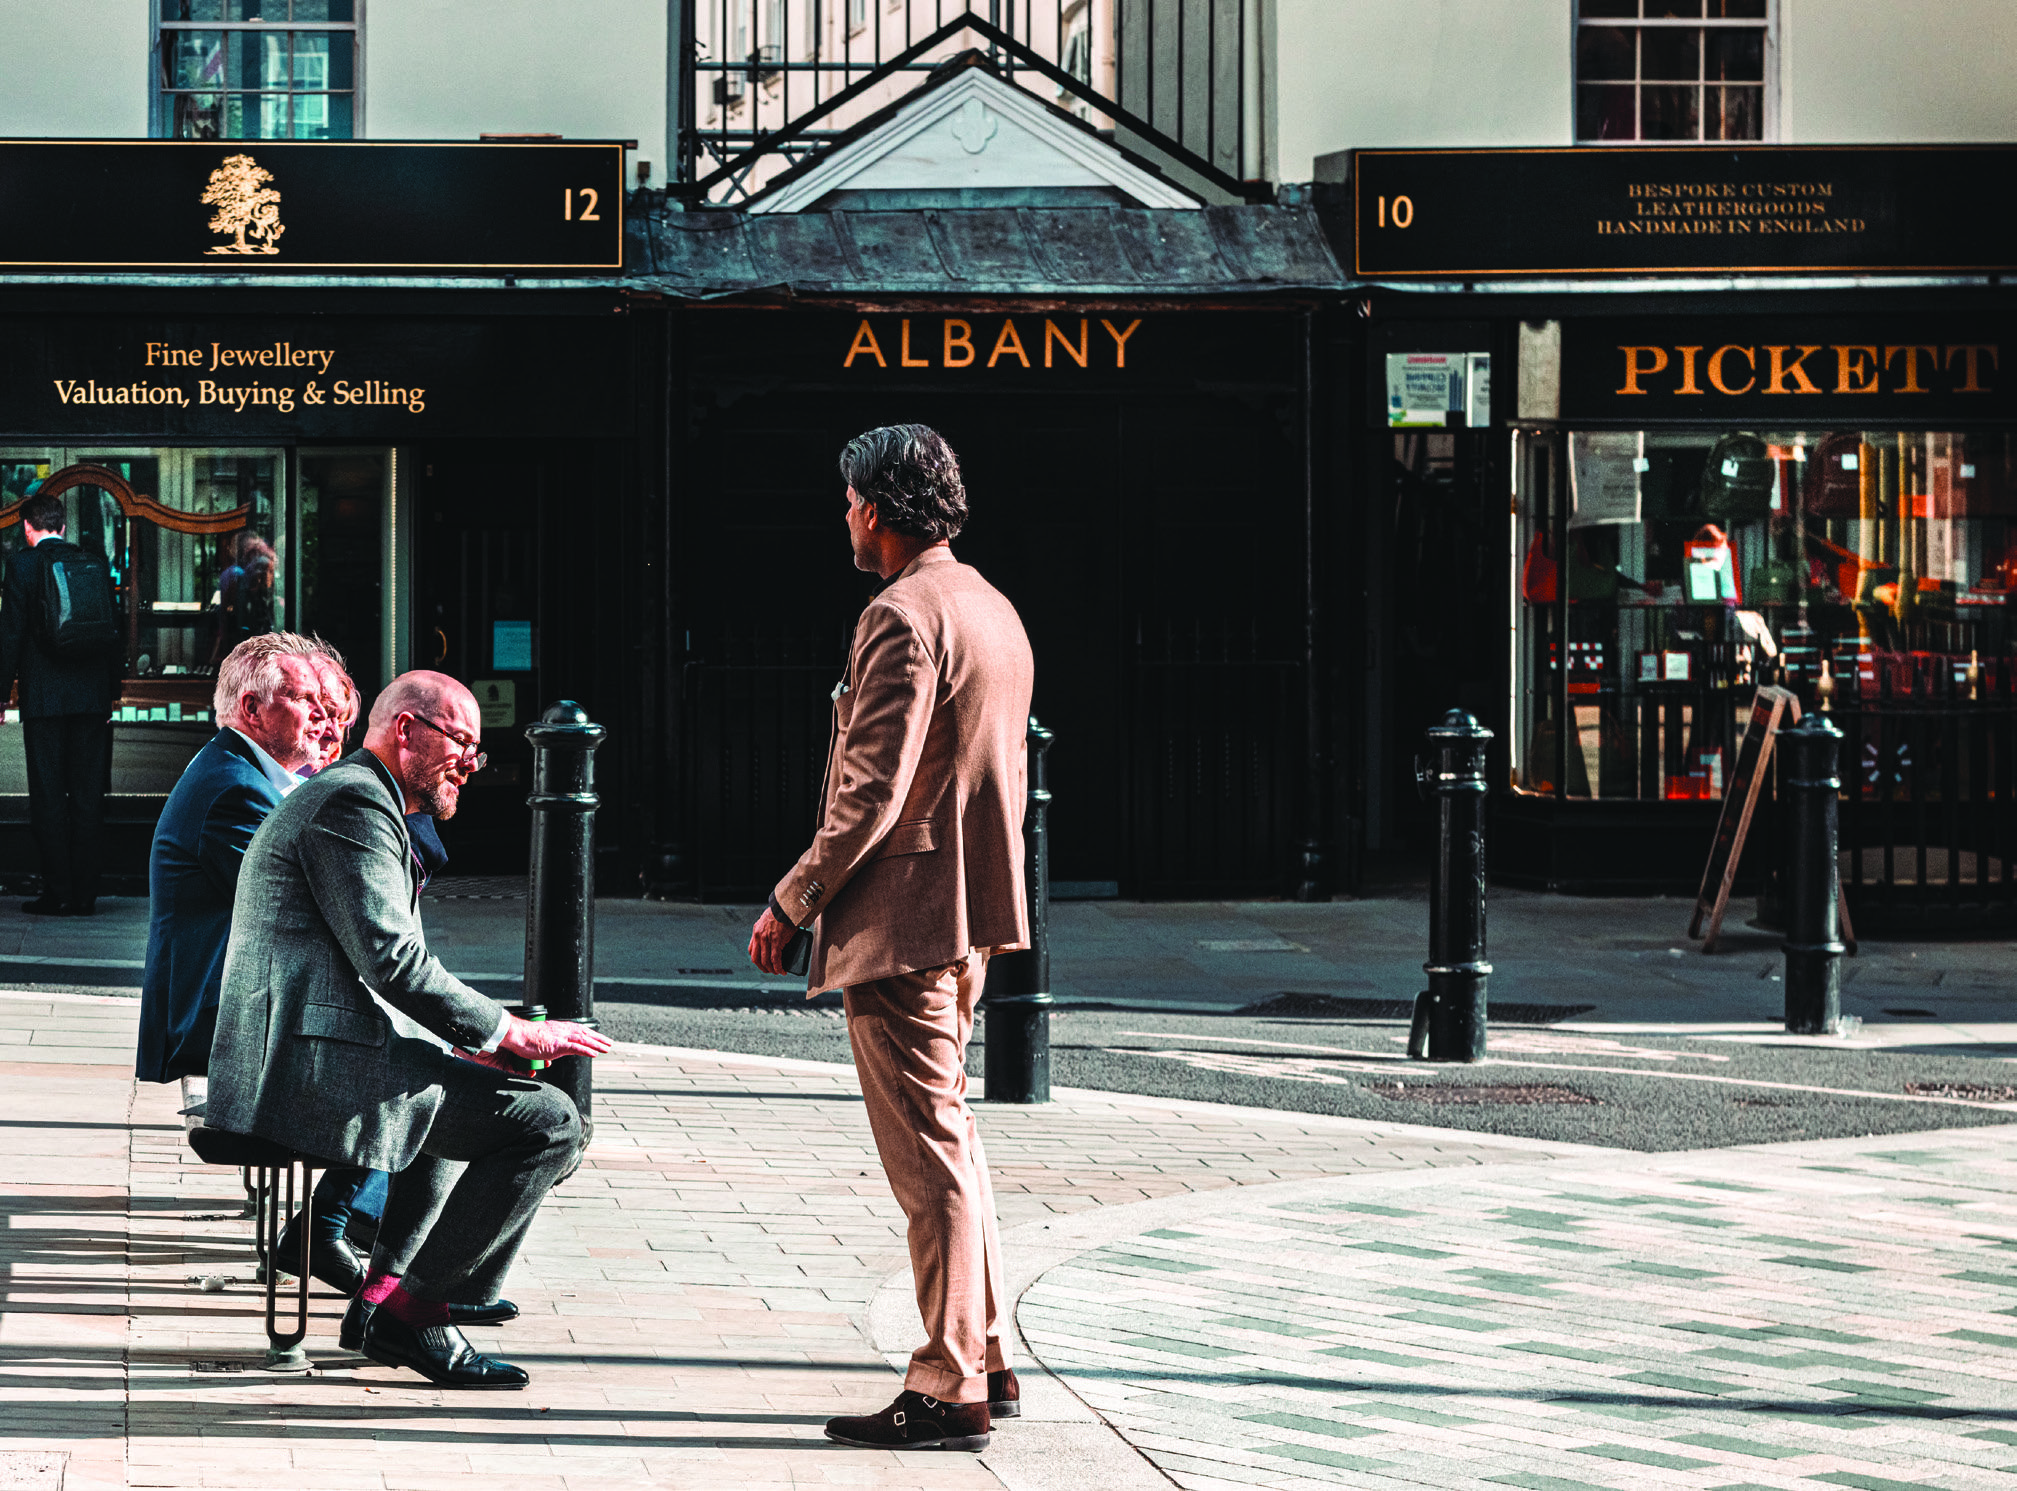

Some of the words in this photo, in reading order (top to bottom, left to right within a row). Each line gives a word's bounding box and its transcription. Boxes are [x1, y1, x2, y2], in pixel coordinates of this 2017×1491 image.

[564, 187, 600, 221] 12
[1628, 183, 1736, 198] BESPOKE
[1741, 183, 1833, 197] CUSTOM
[1378, 195, 1414, 229] 10
[1636, 201, 1826, 216] LEATHERGOODS
[1597, 219, 1722, 234] HANDMADE
[1728, 220, 1751, 233] IN
[1758, 219, 1866, 234] ENGLAND
[144, 342, 203, 367] Fine
[209, 342, 336, 372] Jewellery
[843, 318, 1142, 368] ALBANY
[1615, 344, 2000, 395] PICKETT
[54, 379, 190, 409] Valuation,
[198, 379, 295, 413] Buying
[303, 380, 326, 405] &
[333, 380, 426, 414] Selling
